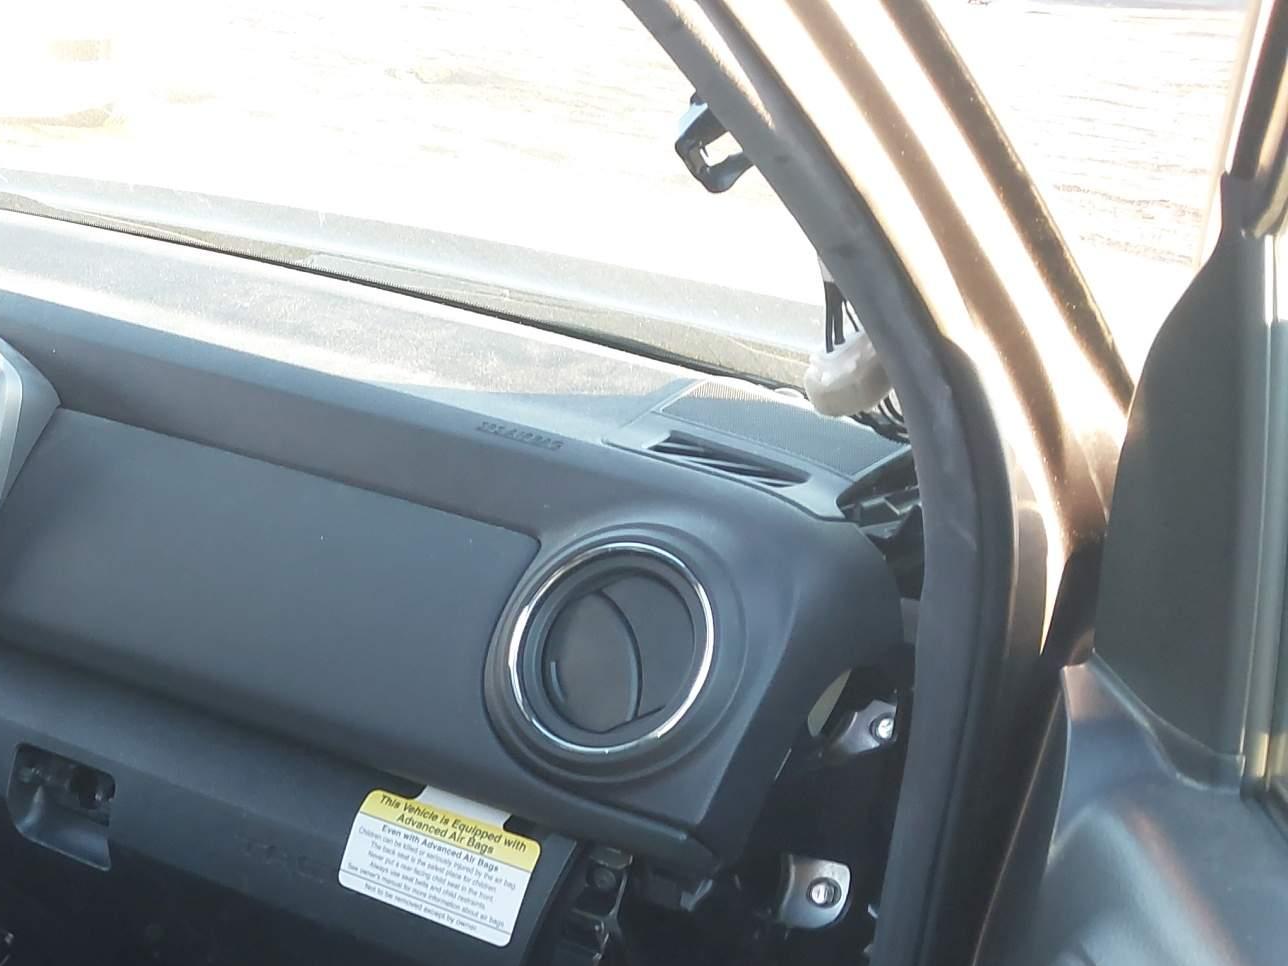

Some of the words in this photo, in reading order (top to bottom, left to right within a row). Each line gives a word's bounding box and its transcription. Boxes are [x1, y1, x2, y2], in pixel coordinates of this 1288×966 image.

[380, 794, 401, 809] This
[403, 802, 439, 821] Vehicle
[439, 815, 450, 824] is
[450, 818, 502, 845] Equipped
[503, 837, 527, 851] with
[396, 813, 448, 837] Advanced
[448, 831, 465, 843] Air
[465, 838, 494, 856] Bags
[381, 825, 401, 836] Even
[403, 832, 420, 843] with
[421, 838, 462, 858] Advanced
[463, 854, 475, 862] Air
[476, 859, 499, 873] Bags
